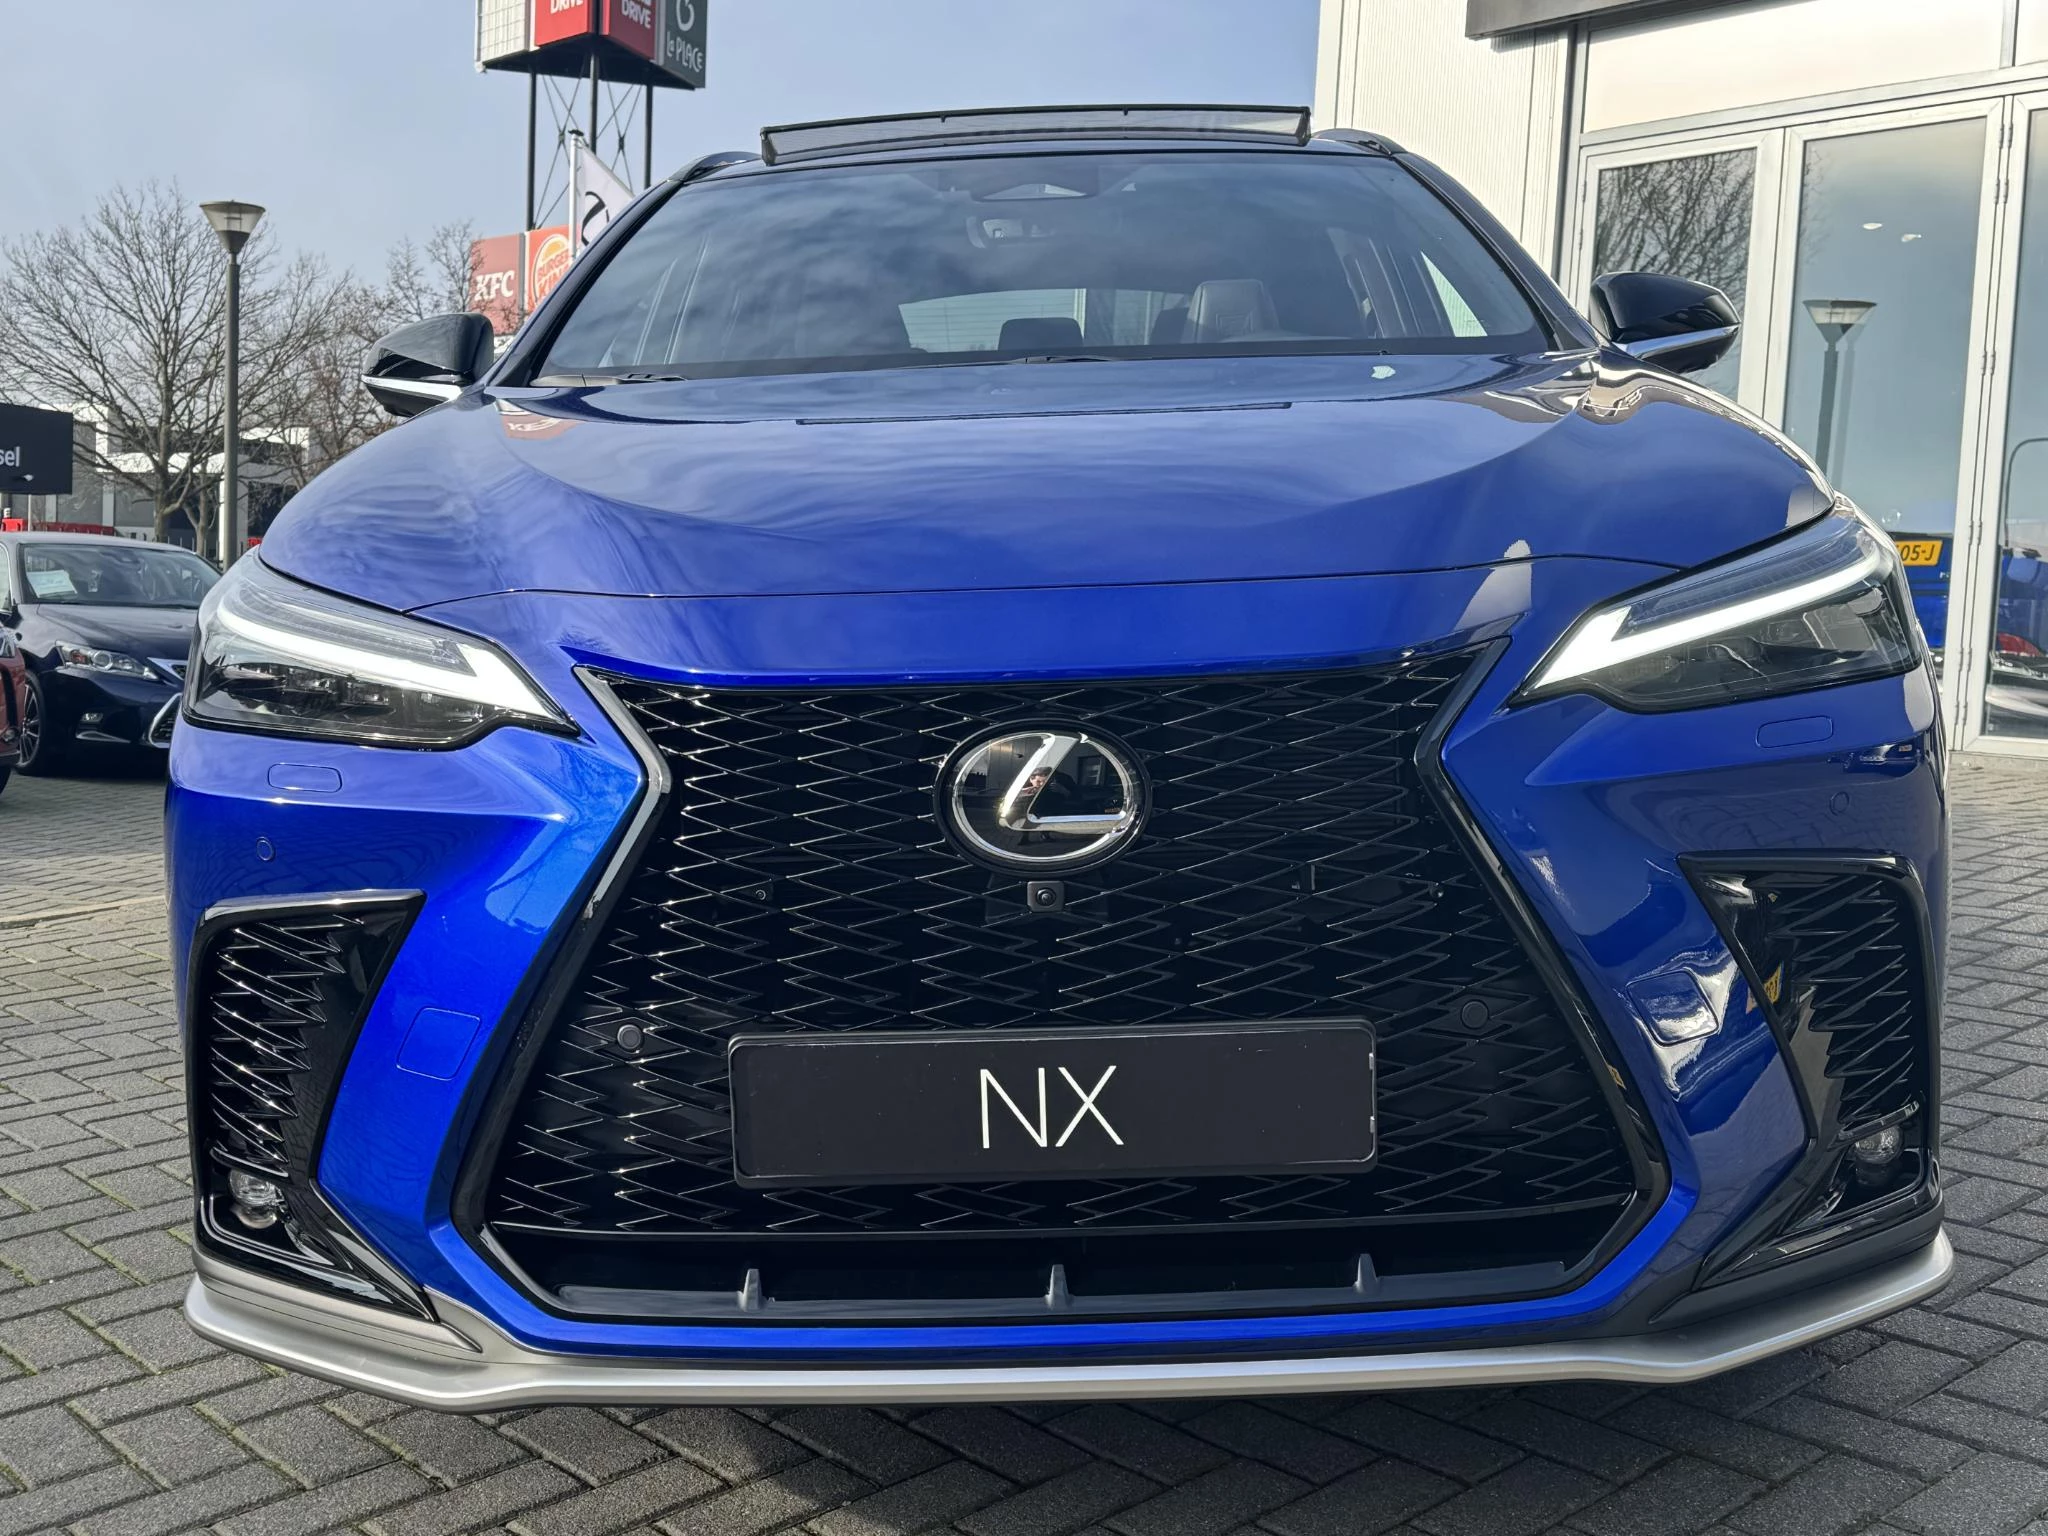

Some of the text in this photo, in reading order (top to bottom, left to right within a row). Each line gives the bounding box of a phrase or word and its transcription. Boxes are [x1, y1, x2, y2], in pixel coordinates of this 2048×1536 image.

[621, 0, 651, 29] DRIVE
[474, 270, 515, 300] KFC
[1896, 544, 1935, 561] 05-J
[980, 1065, 1124, 1149] NX
